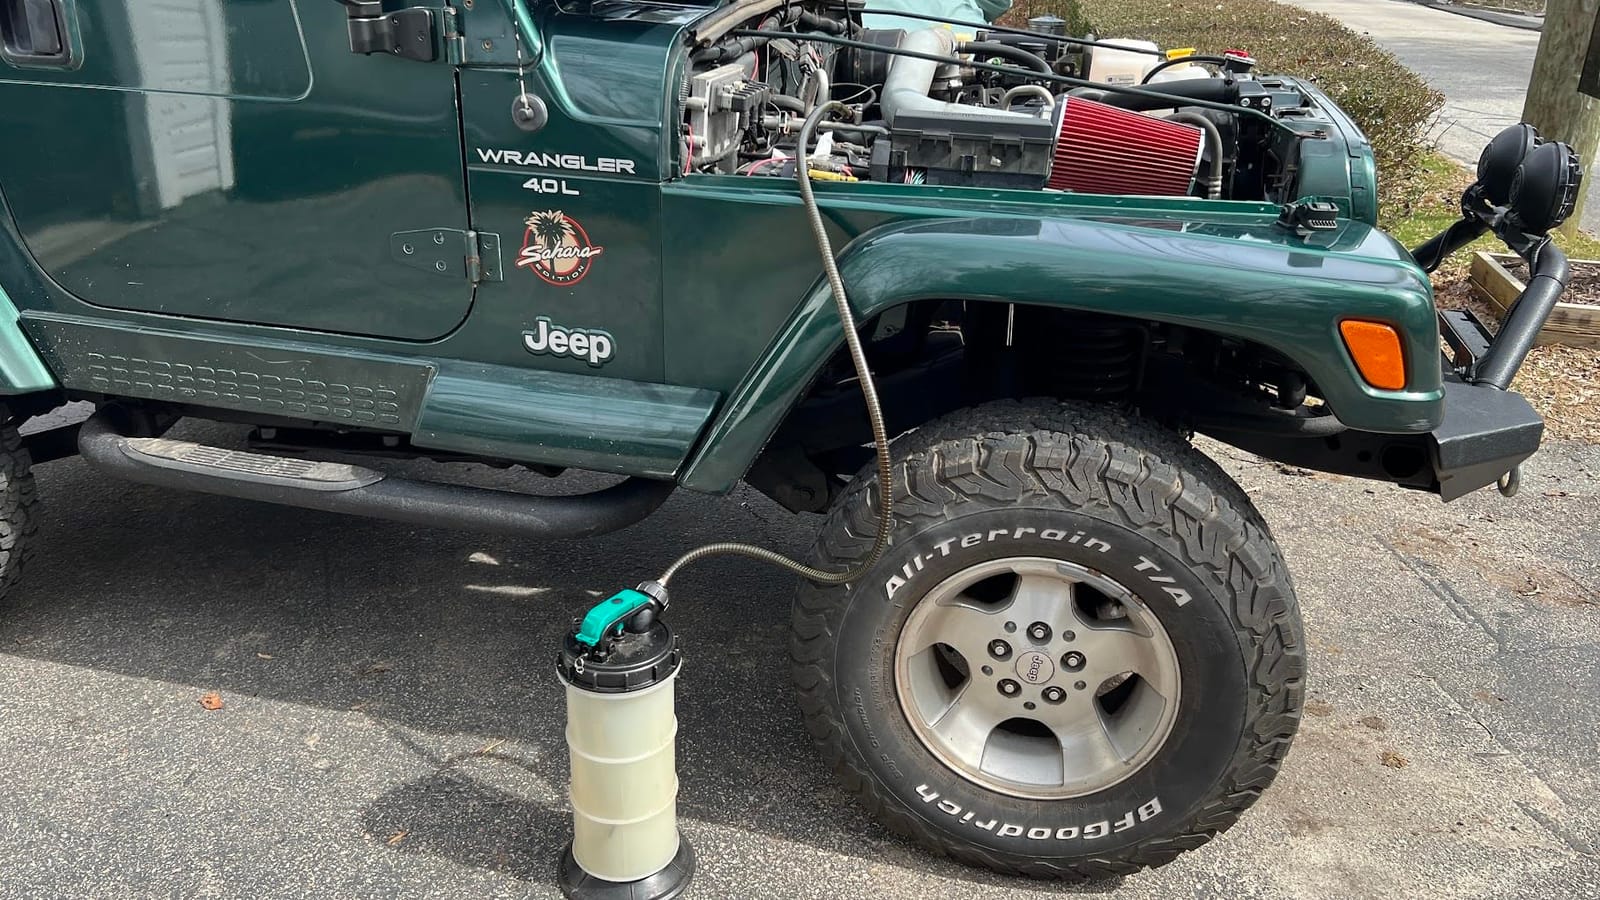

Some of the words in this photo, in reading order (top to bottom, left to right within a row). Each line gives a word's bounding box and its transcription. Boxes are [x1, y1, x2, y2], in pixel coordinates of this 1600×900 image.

[477, 148, 636, 174] WRANGLER
[516, 241, 603, 266] Sahara
[535, 263, 585, 282] EDITION
[523, 319, 613, 364] Jeep
[884, 526, 1112, 600] All-Terrain
[1132, 555, 1193, 608] T/A
[1027, 655, 1043, 681] Jeep
[914, 783, 1164, 841] BFGoodrich
